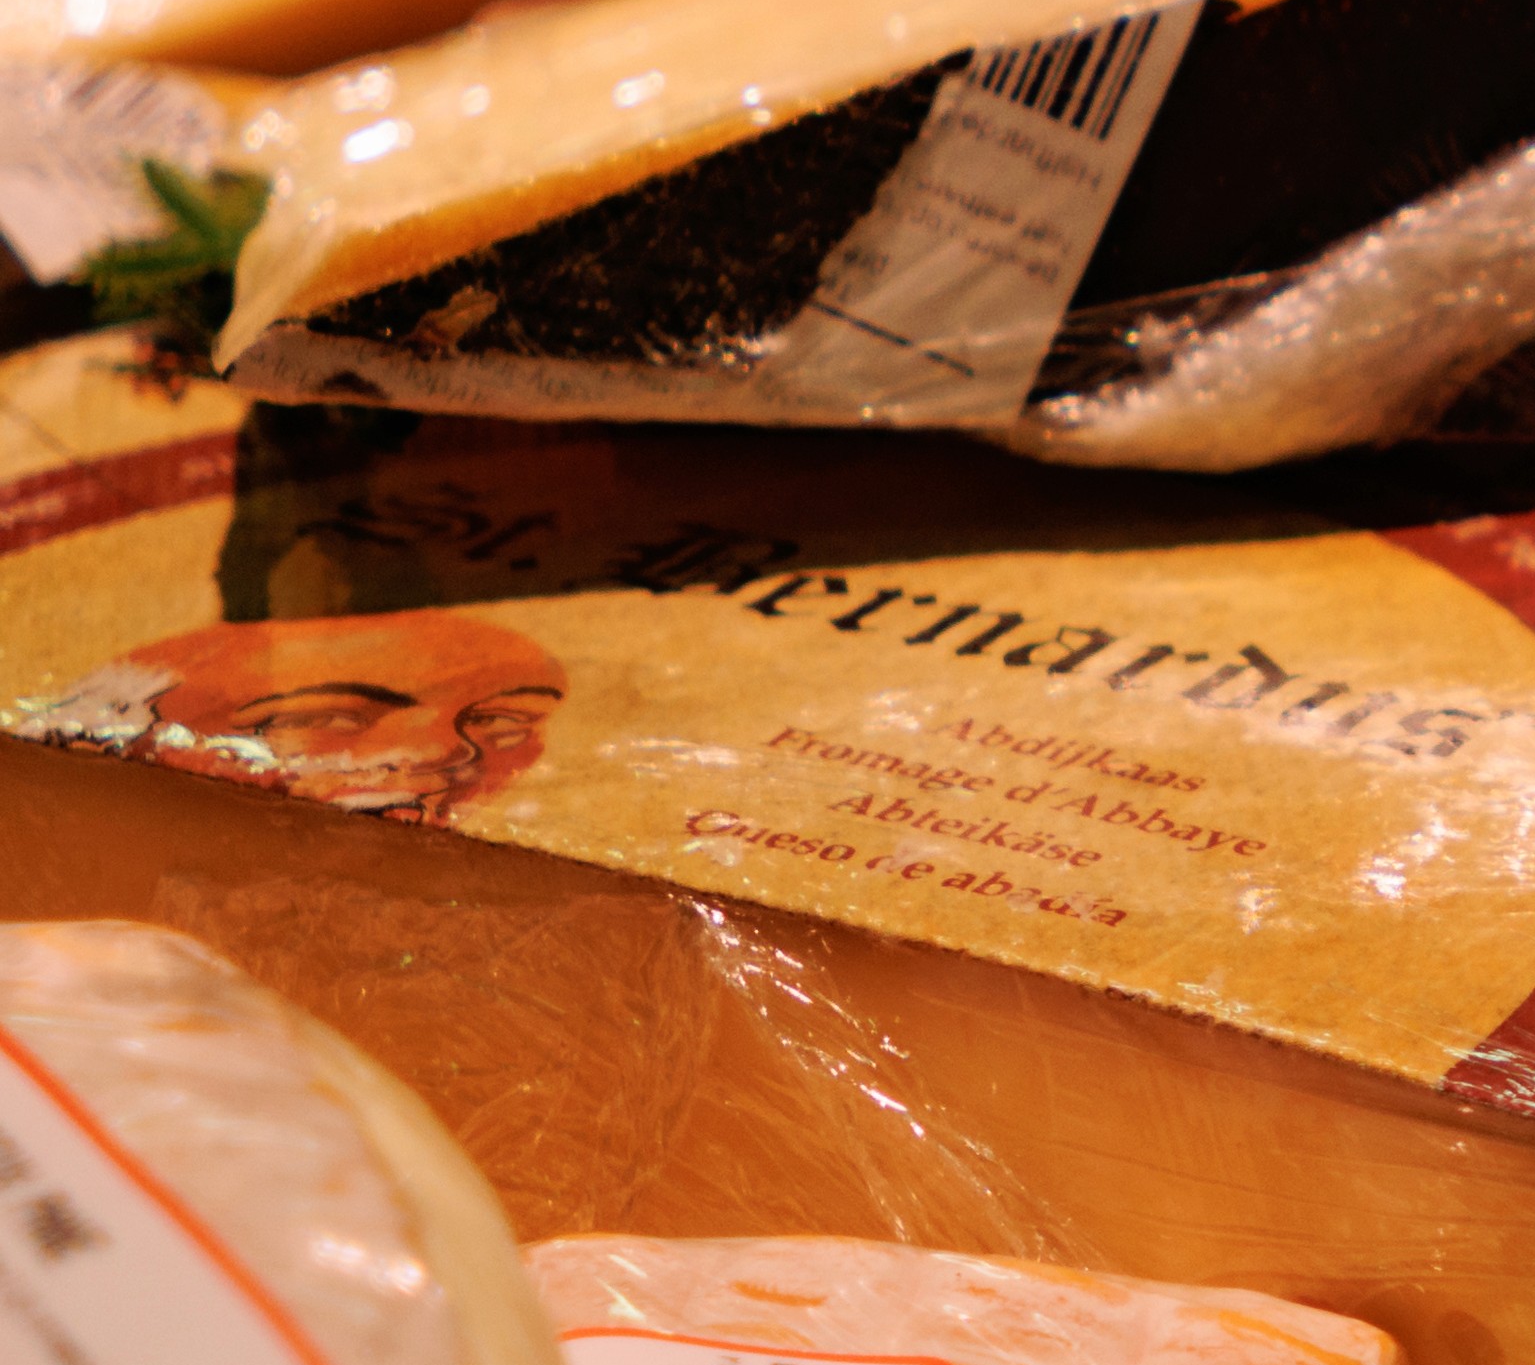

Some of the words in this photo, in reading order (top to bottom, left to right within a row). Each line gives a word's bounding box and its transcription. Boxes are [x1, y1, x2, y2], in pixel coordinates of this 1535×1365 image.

[765, 725, 996, 793] Fromage
[930, 716, 1209, 793] Abdijkaas
[683, 808, 858, 864] Queso
[826, 791, 1104, 871] Abteikäse
